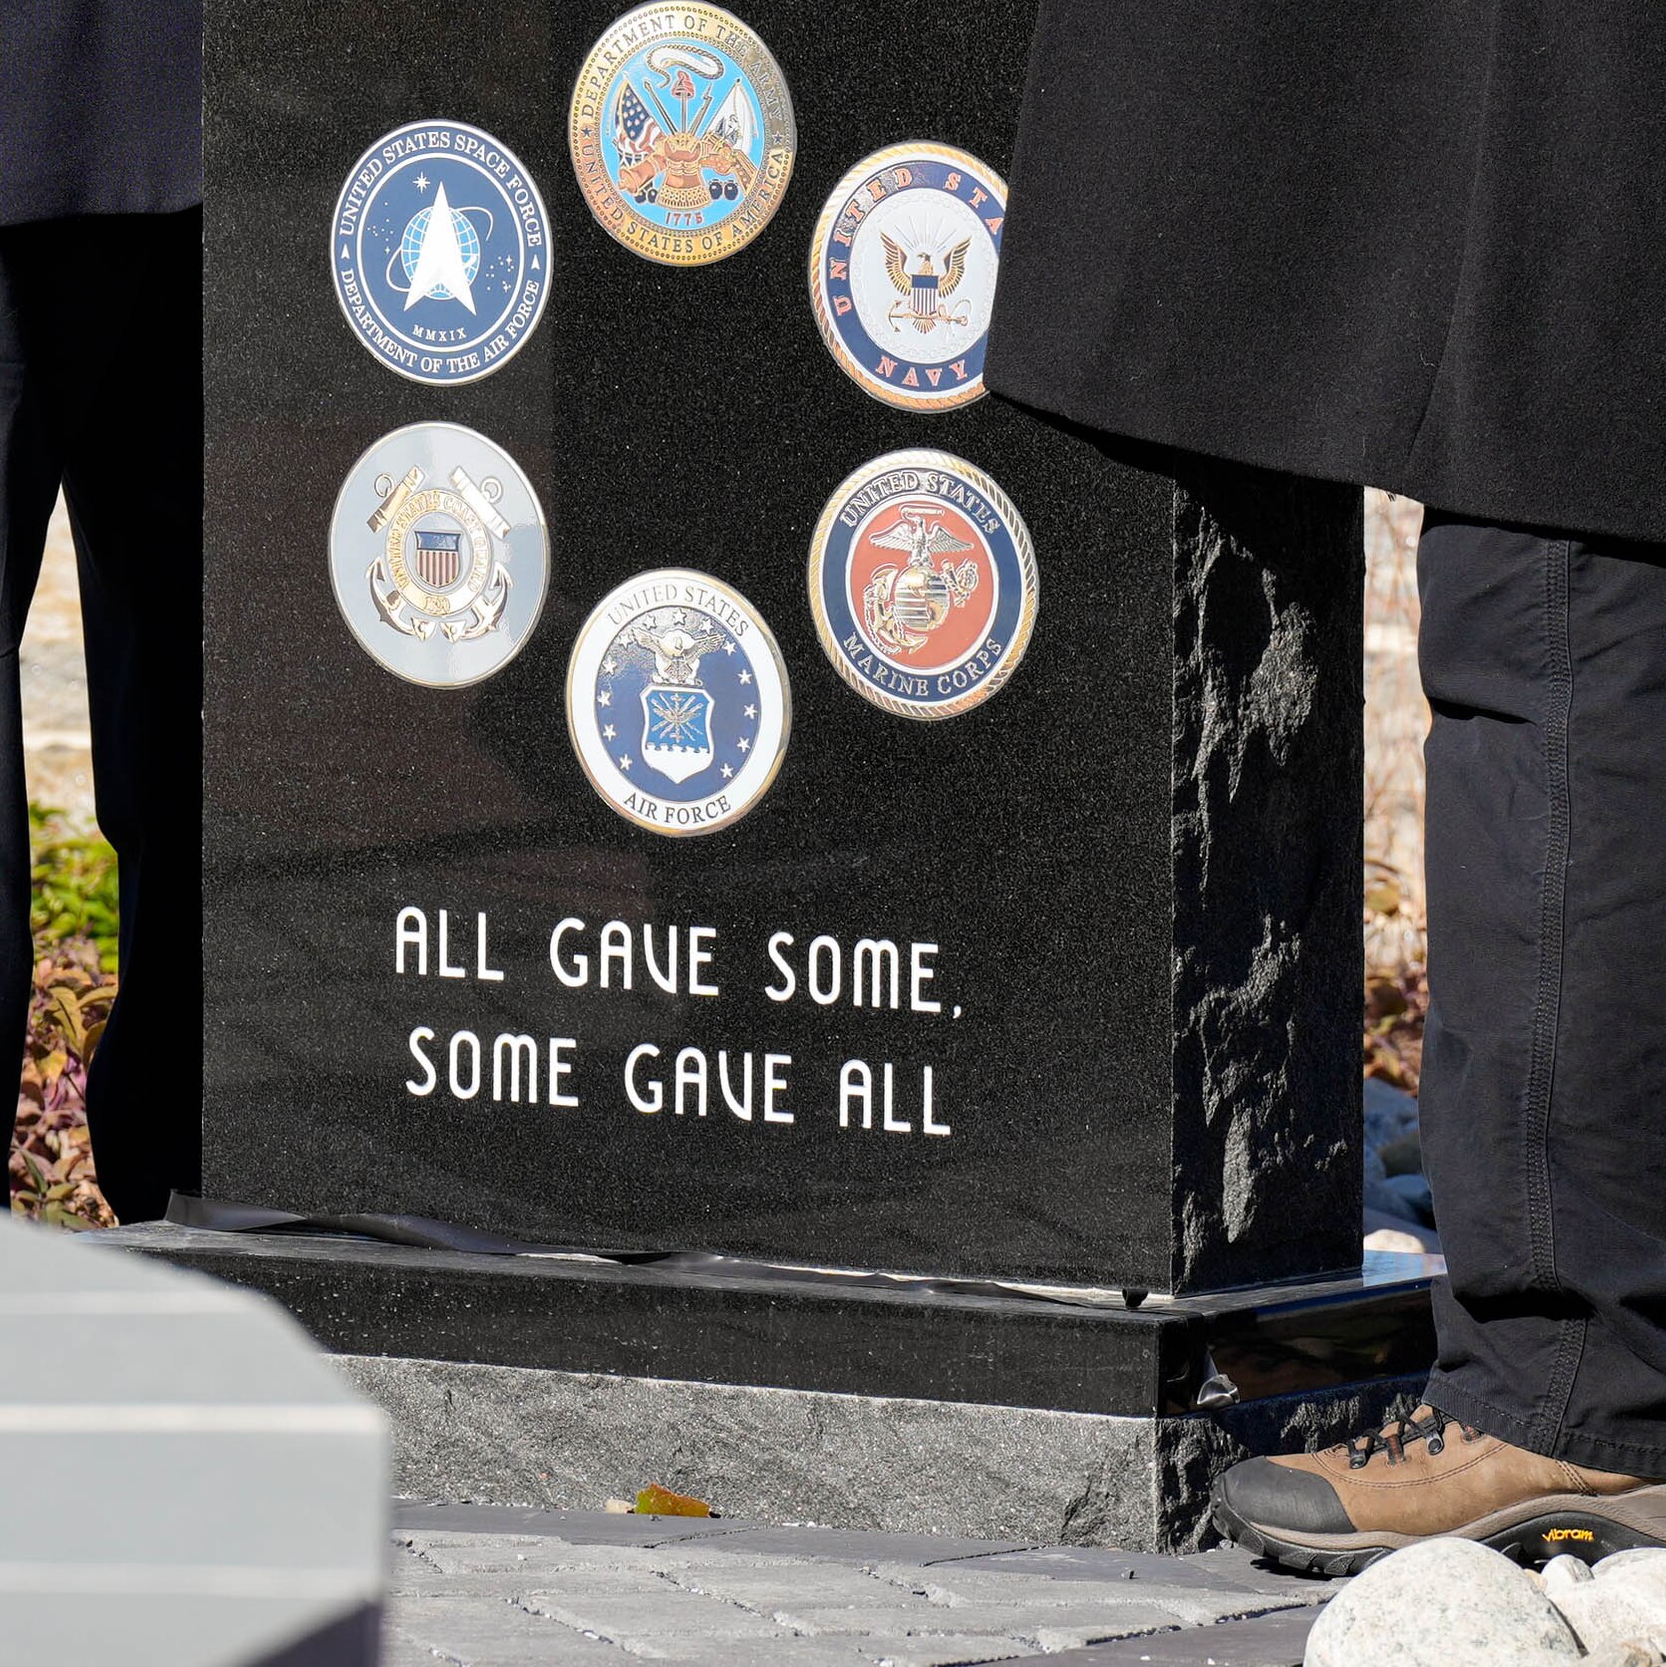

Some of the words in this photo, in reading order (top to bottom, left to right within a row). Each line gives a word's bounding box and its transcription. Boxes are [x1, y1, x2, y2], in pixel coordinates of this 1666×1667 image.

[582, 14, 675, 118] DEPARTMENT
[684, 14, 709, 33] OF
[717, 26, 749, 58] THE
[750, 61, 783, 121] ARMY
[339, 157, 384, 235] UNITED
[382, 131, 450, 163] STATES
[454, 134, 510, 179] SPACE
[506, 174, 542, 247] FORCE
[582, 143, 624, 221] UNITED
[626, 222, 693, 253] STATES
[702, 231, 726, 251] OF
[731, 149, 784, 238] AMERICA
[665, 211, 703, 226] 1775
[829, 168, 913, 316] UNITED
[944, 173, 1005, 235] STA
[341, 268, 418, 367] DEPARTMENT
[421, 356, 442, 373] OF
[446, 352, 481, 373] THE
[483, 336, 509, 363] AIR
[505, 279, 540, 340] FORCE
[413, 324, 467, 342] MMXIX
[876, 356, 968, 387] NAVY
[839, 470, 919, 528] UNITED
[924, 472, 1001, 534] STATES
[607, 584, 678, 626] UNITED
[684, 585, 749, 637] STATES
[843, 632, 929, 697] MARINE
[937, 637, 1003, 694] CORPS
[623, 792, 658, 821] AIR
[664, 795, 731, 825] FORCE
[395, 905, 505, 982] ALL
[549, 917, 719, 997] GAVE
[765, 931, 962, 1020] SOME,
[405, 1026, 580, 1108] SOME
[624, 1043, 795, 1124] GAVE
[839, 1059, 951, 1136] ALL
[1542, 1528, 1594, 1543] vibram
